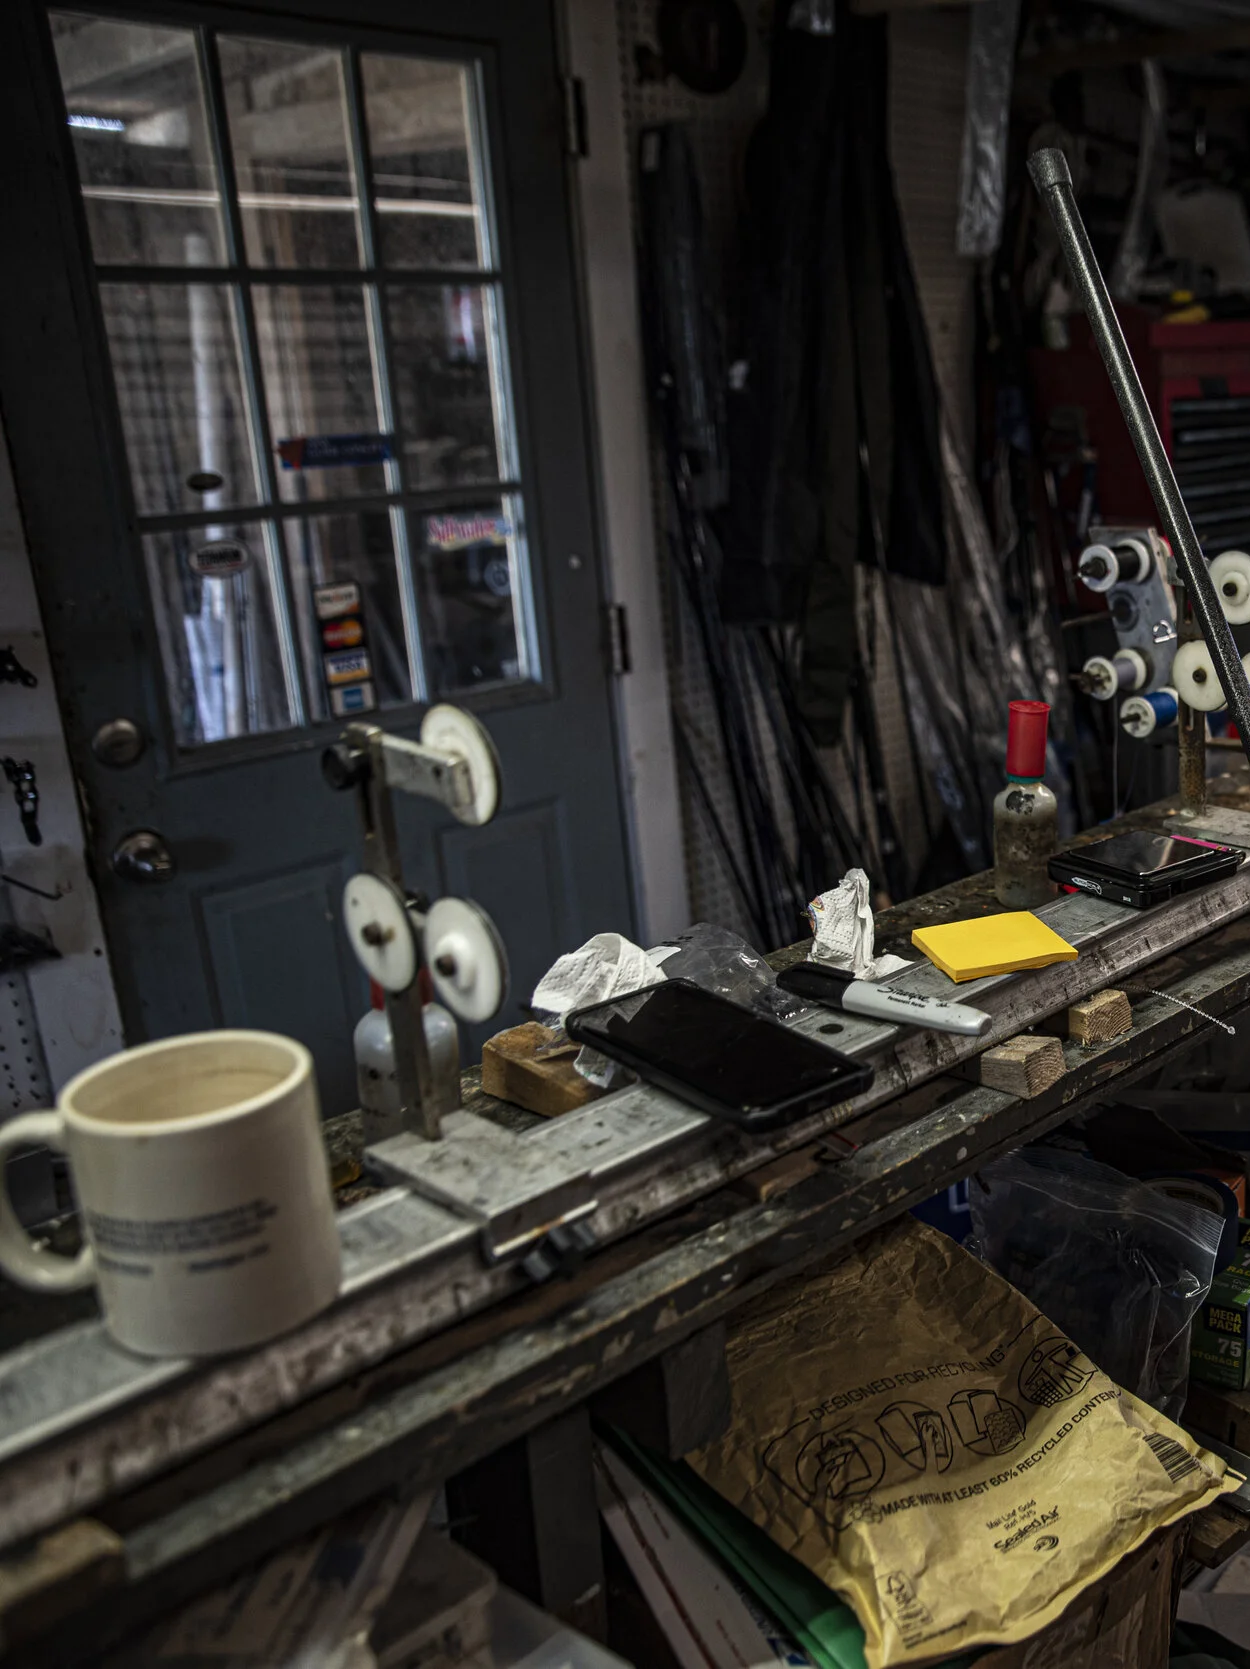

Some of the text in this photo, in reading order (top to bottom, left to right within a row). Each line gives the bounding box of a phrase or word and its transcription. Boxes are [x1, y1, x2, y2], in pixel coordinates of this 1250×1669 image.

[1209, 1306, 1242, 1324] MEGA
[1208, 1317, 1242, 1334] PACK
[1217, 1338, 1242, 1358] 75
[808, 1376, 897, 1421] DESIGNED
[895, 1369, 929, 1387] FOR
[881, 1495, 919, 1515] MADE
[941, 1491, 955, 1504] AT
[954, 1480, 990, 1501] LEAST
[1016, 1422, 1074, 1474] RECYCLED
